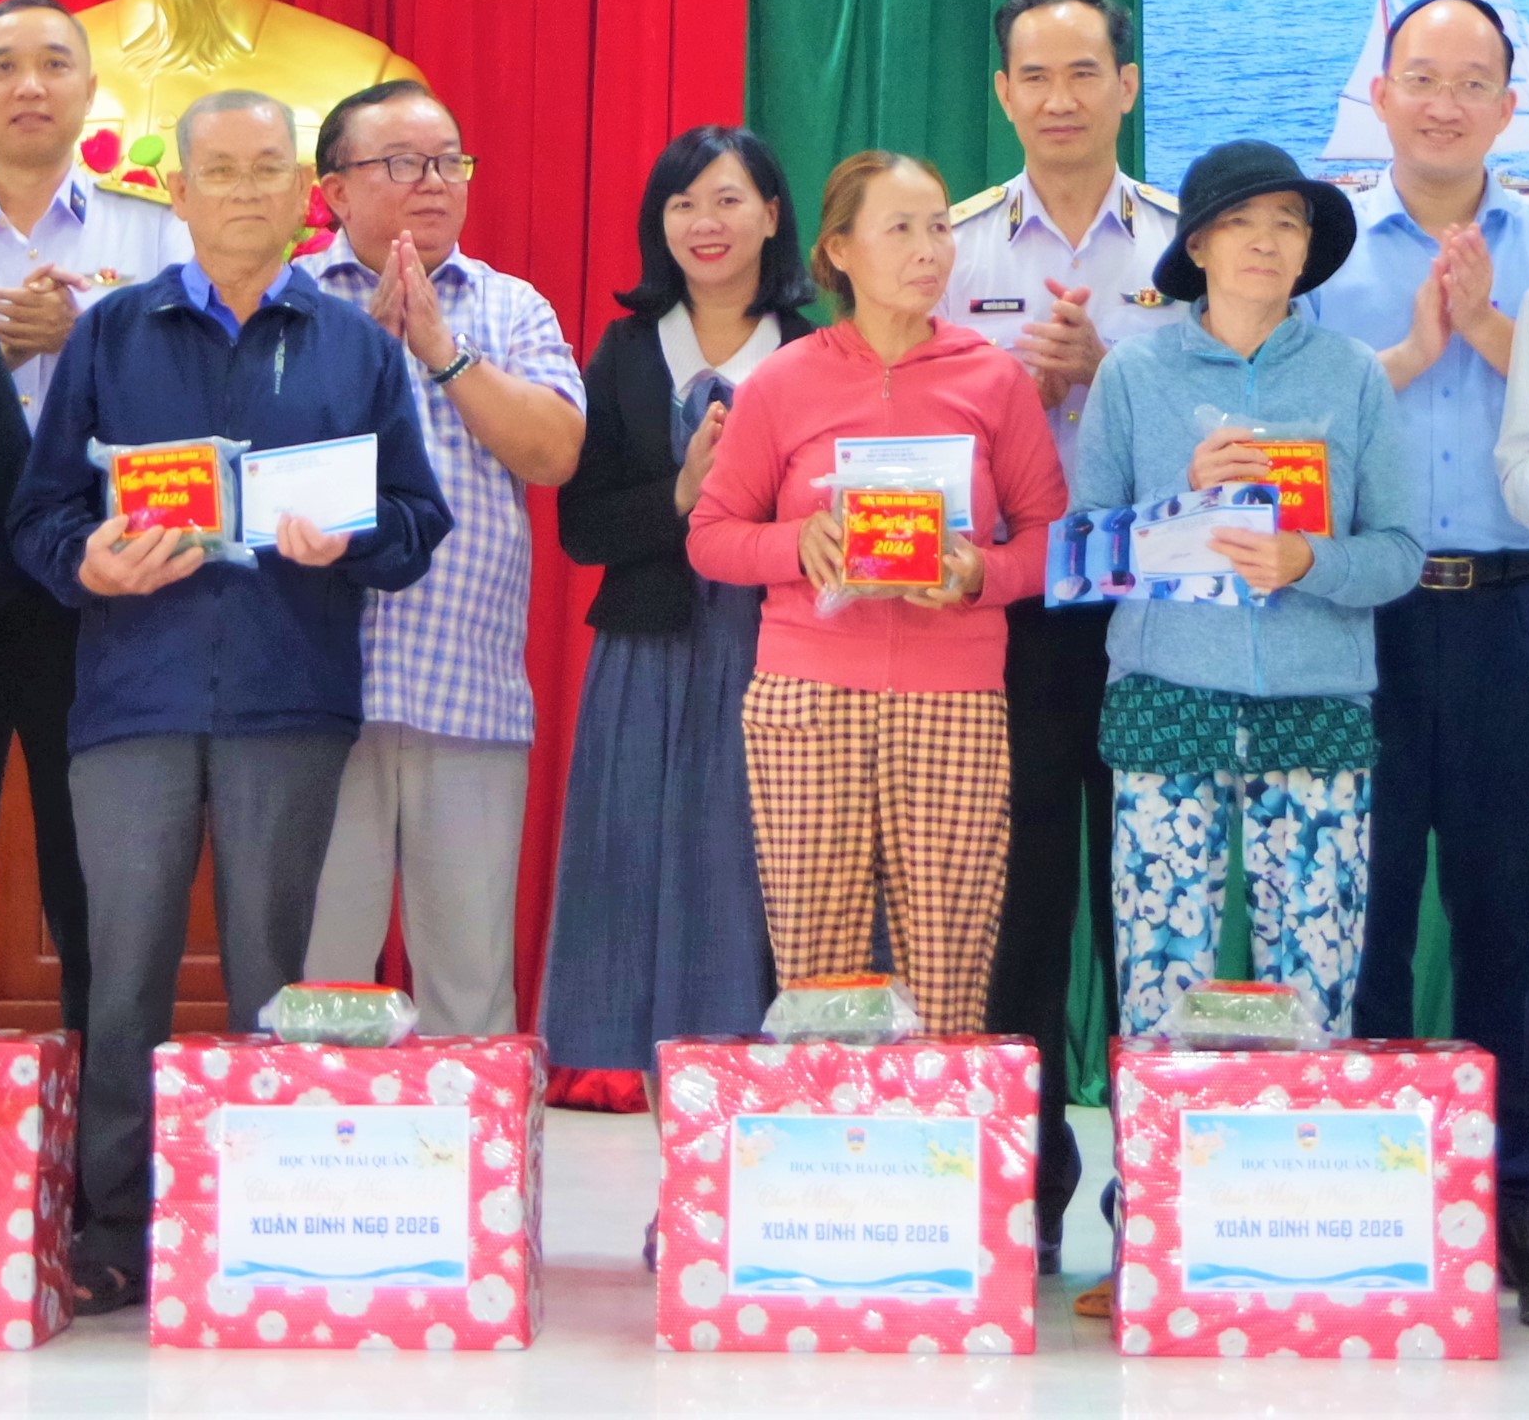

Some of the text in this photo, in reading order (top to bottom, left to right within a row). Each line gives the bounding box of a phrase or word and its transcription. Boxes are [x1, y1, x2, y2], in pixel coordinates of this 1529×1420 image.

[147, 491, 190, 507] 2026
[871, 539, 915, 556] 2026
[250, 1212, 440, 1239] XUÂN BÍNH NGỌ 2026
[761, 1218, 950, 1246] XUÂN BÍNH NGỌ 2026
[1214, 1215, 1404, 1241] XUÂN BÍNH NGỌ 2026
